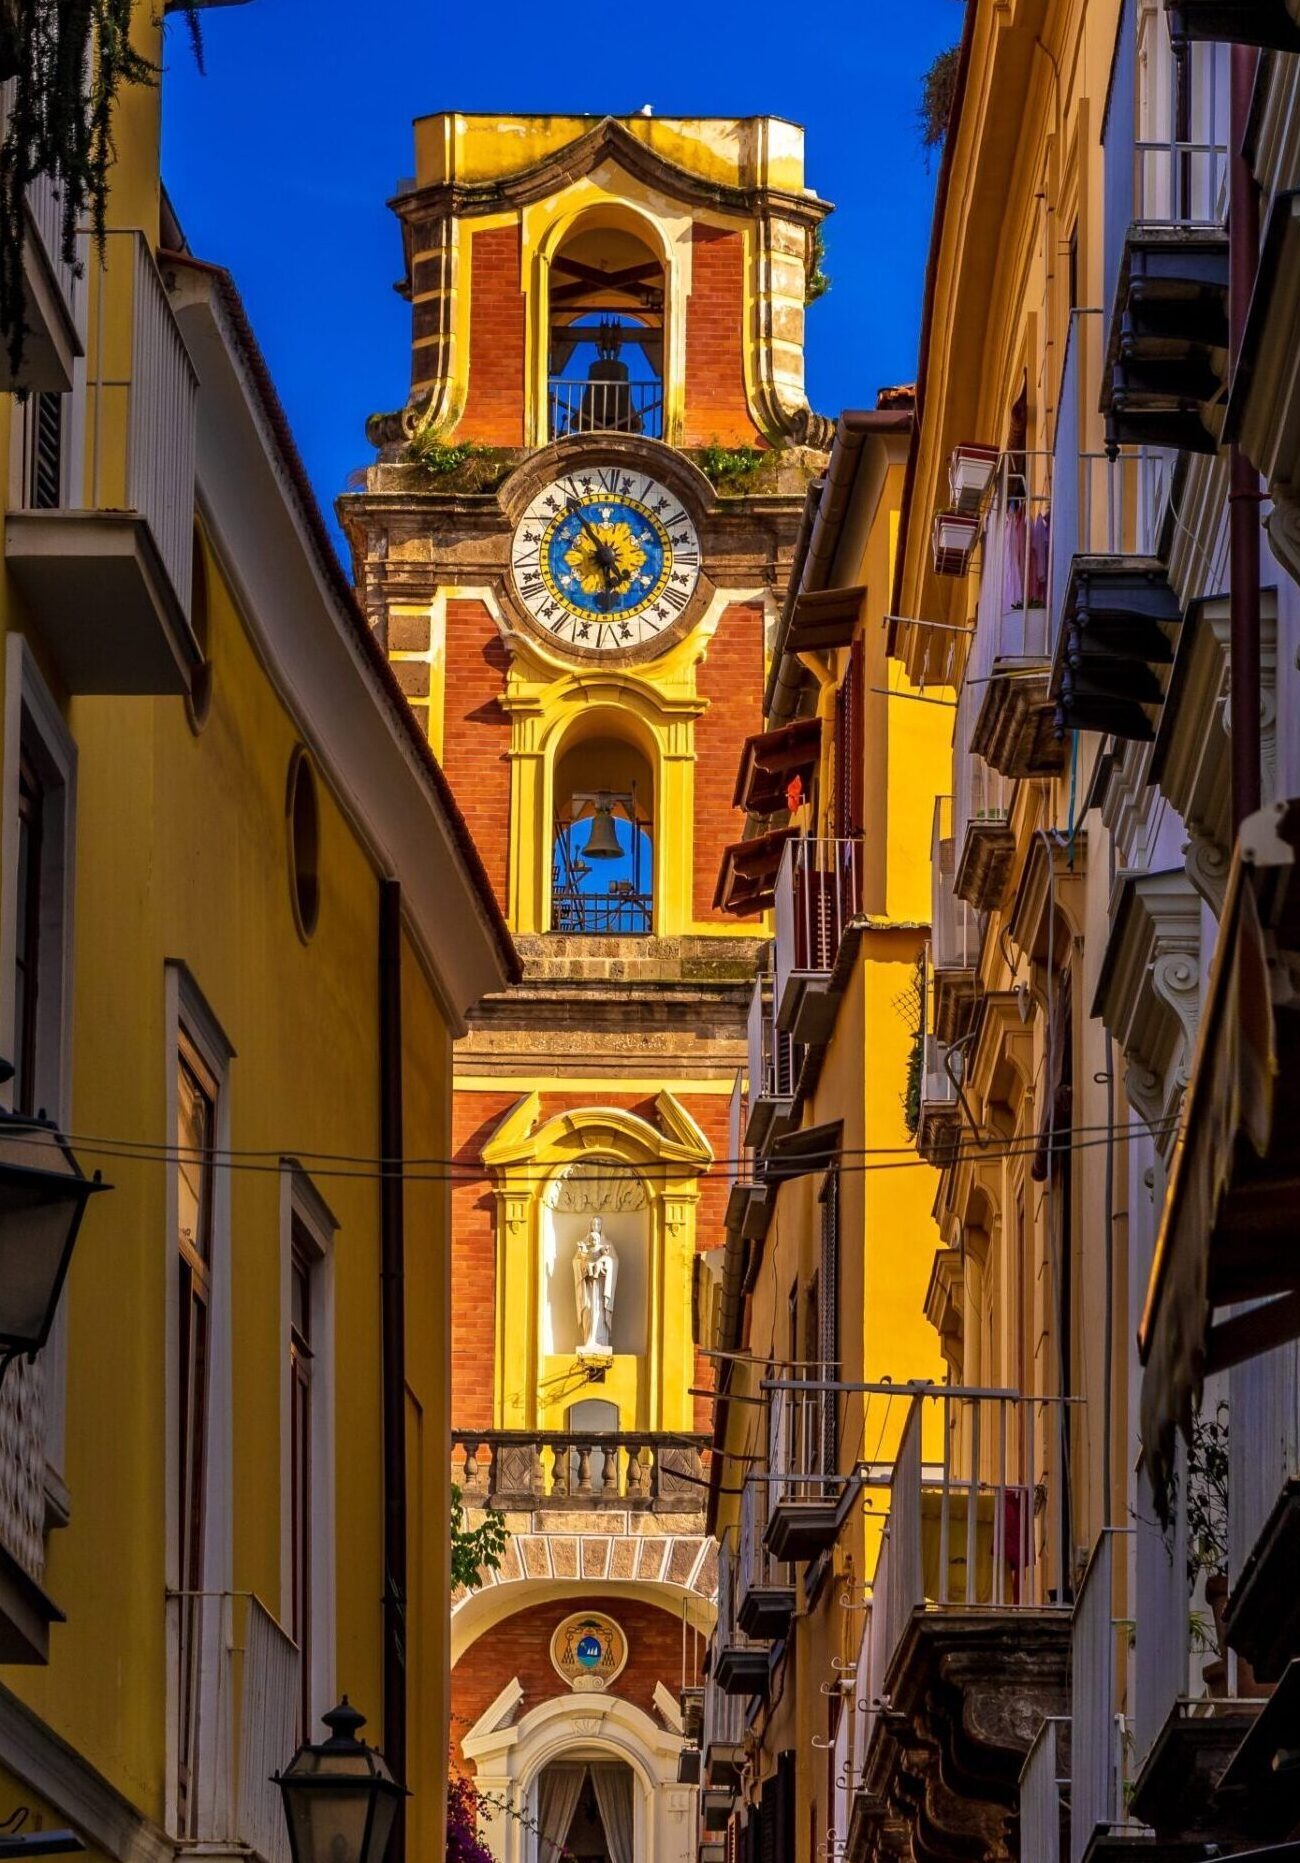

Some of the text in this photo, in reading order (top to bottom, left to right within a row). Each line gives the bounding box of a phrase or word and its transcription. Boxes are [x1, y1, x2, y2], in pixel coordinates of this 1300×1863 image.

[598, 469, 620, 493] XII
[640, 480, 655, 502] I
[524, 505, 553, 530] X
[664, 510, 689, 528] II
[674, 552, 698, 566] III
[520, 582, 549, 616] VIII
[661, 588, 689, 611] IIII
[551, 612, 577, 642] VII
[596, 624, 620, 648] VI
[639, 615, 660, 643] V
